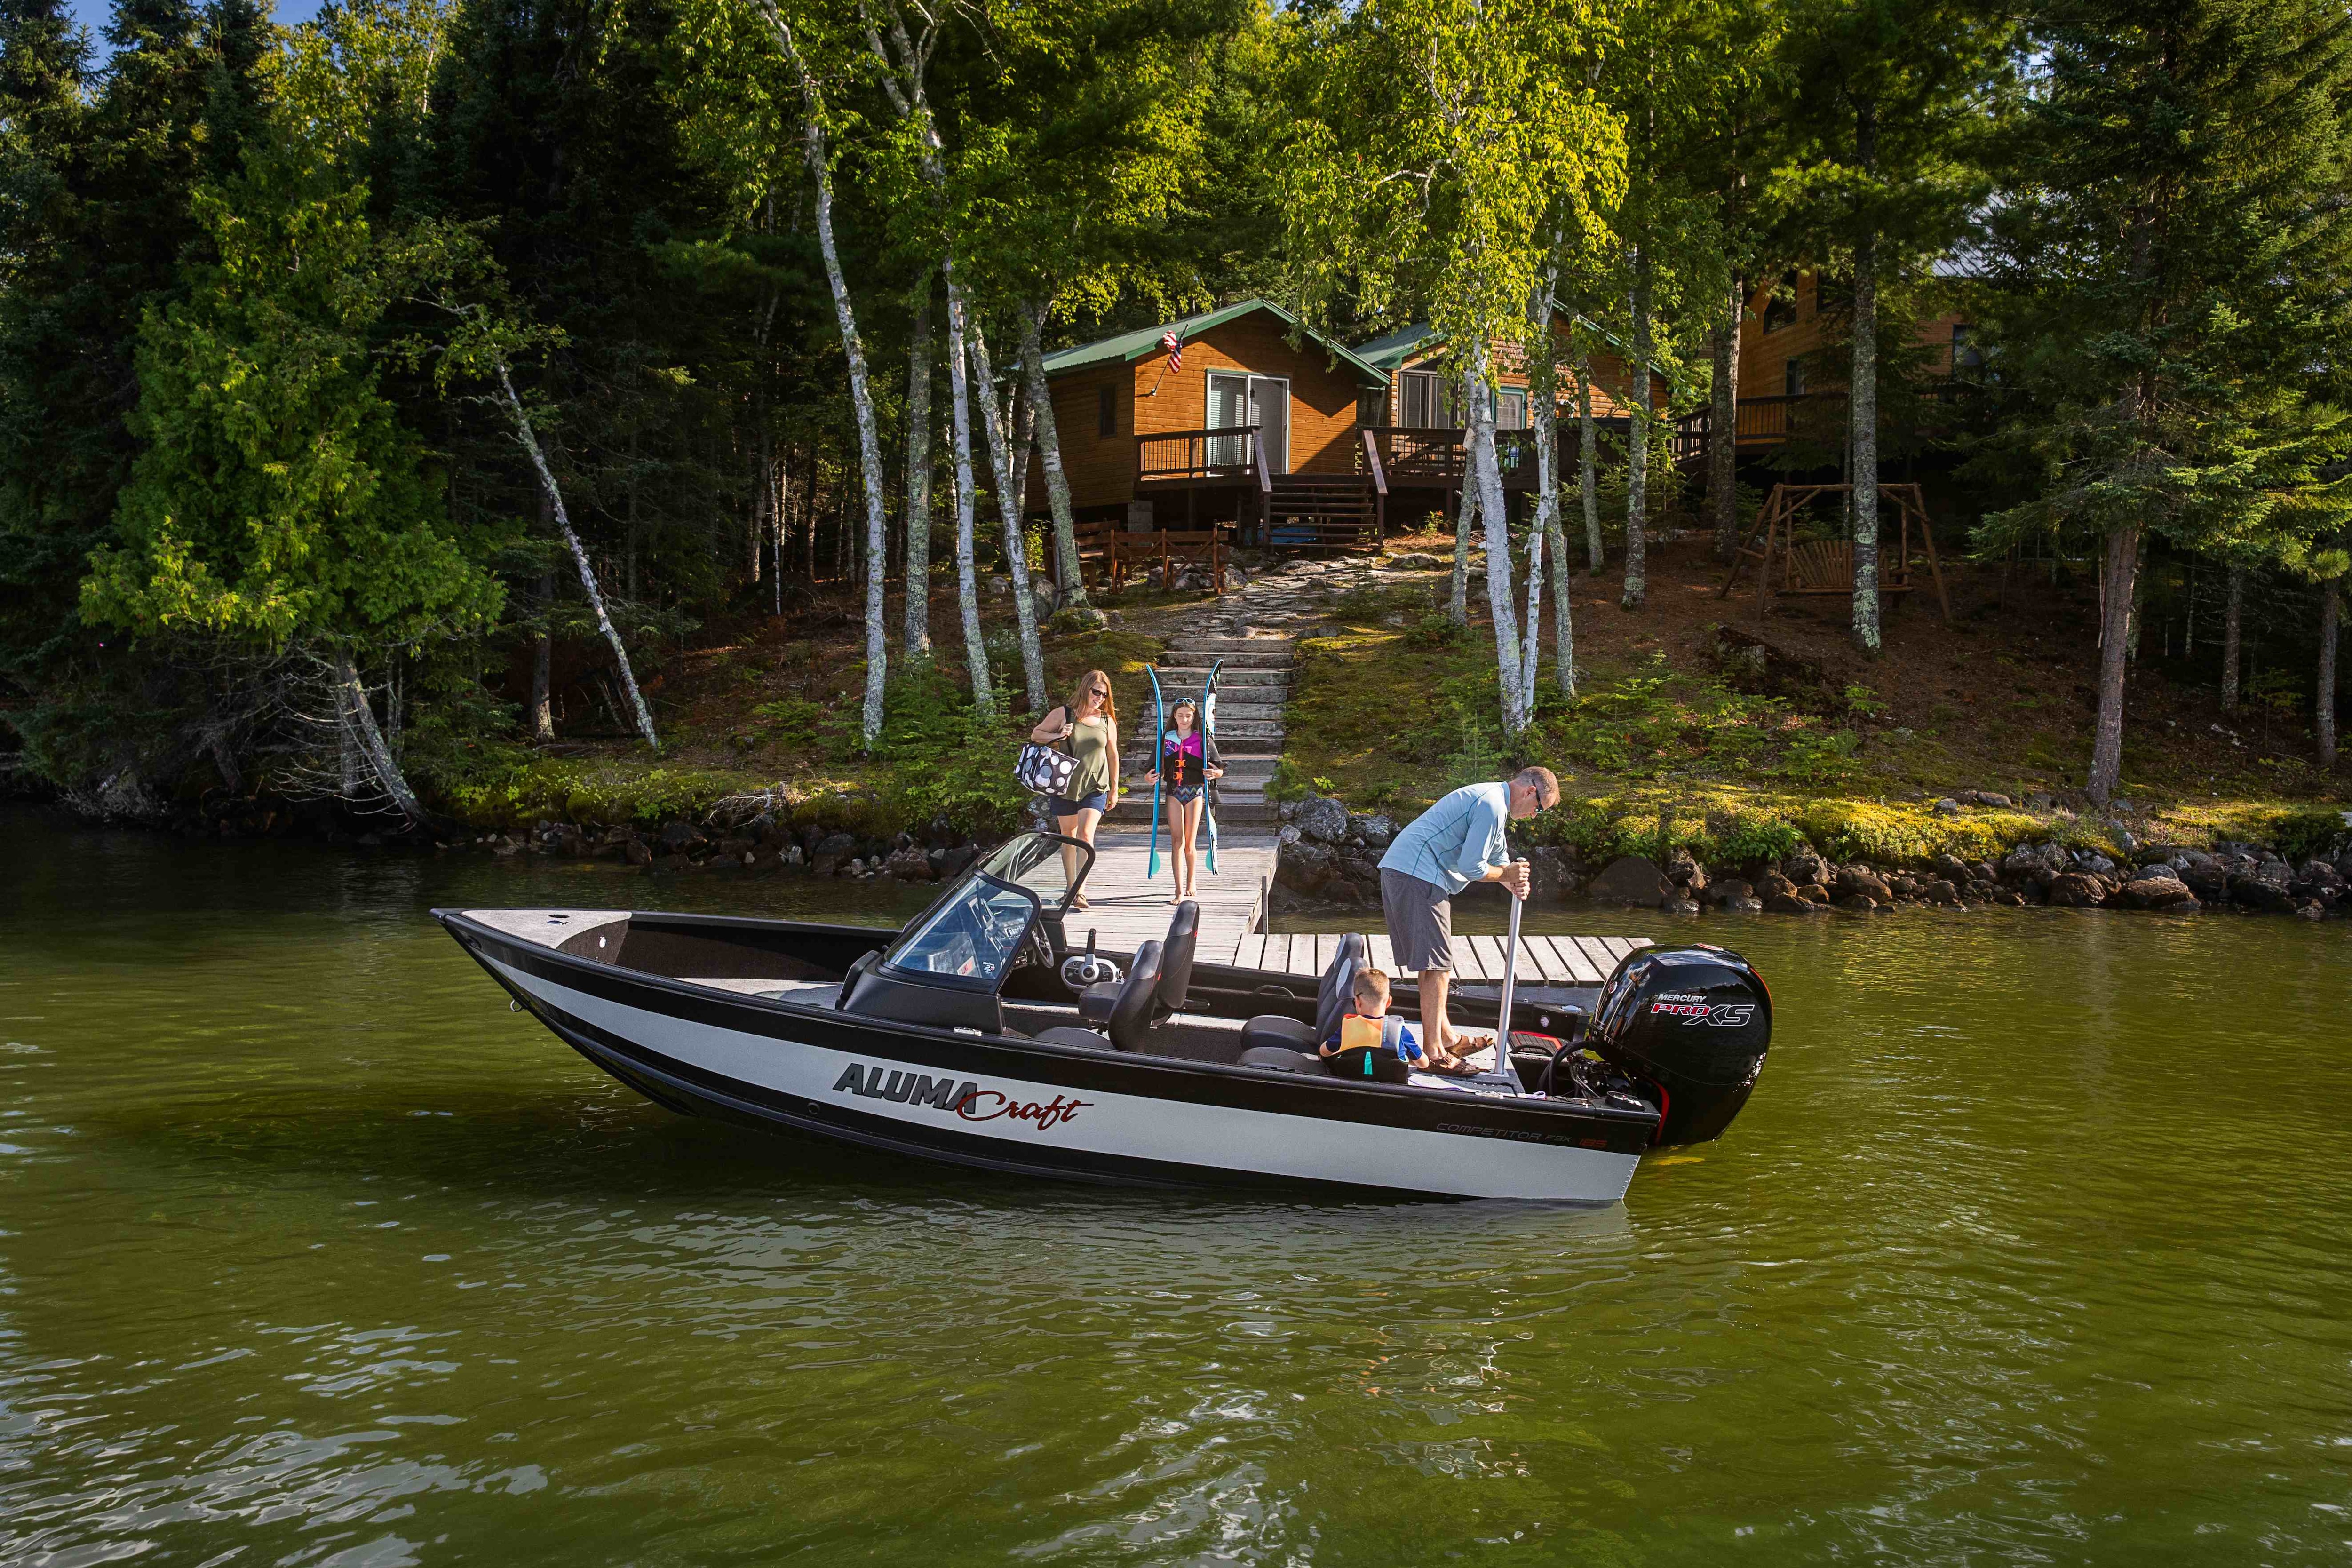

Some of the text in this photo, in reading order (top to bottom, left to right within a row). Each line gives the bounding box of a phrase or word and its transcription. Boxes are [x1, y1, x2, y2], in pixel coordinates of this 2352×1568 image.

[1658, 994, 1707, 1003] MERCURY
[1650, 1003, 1711, 1016] PRO
[1436, 1123, 1542, 1140] COMPETITOR
